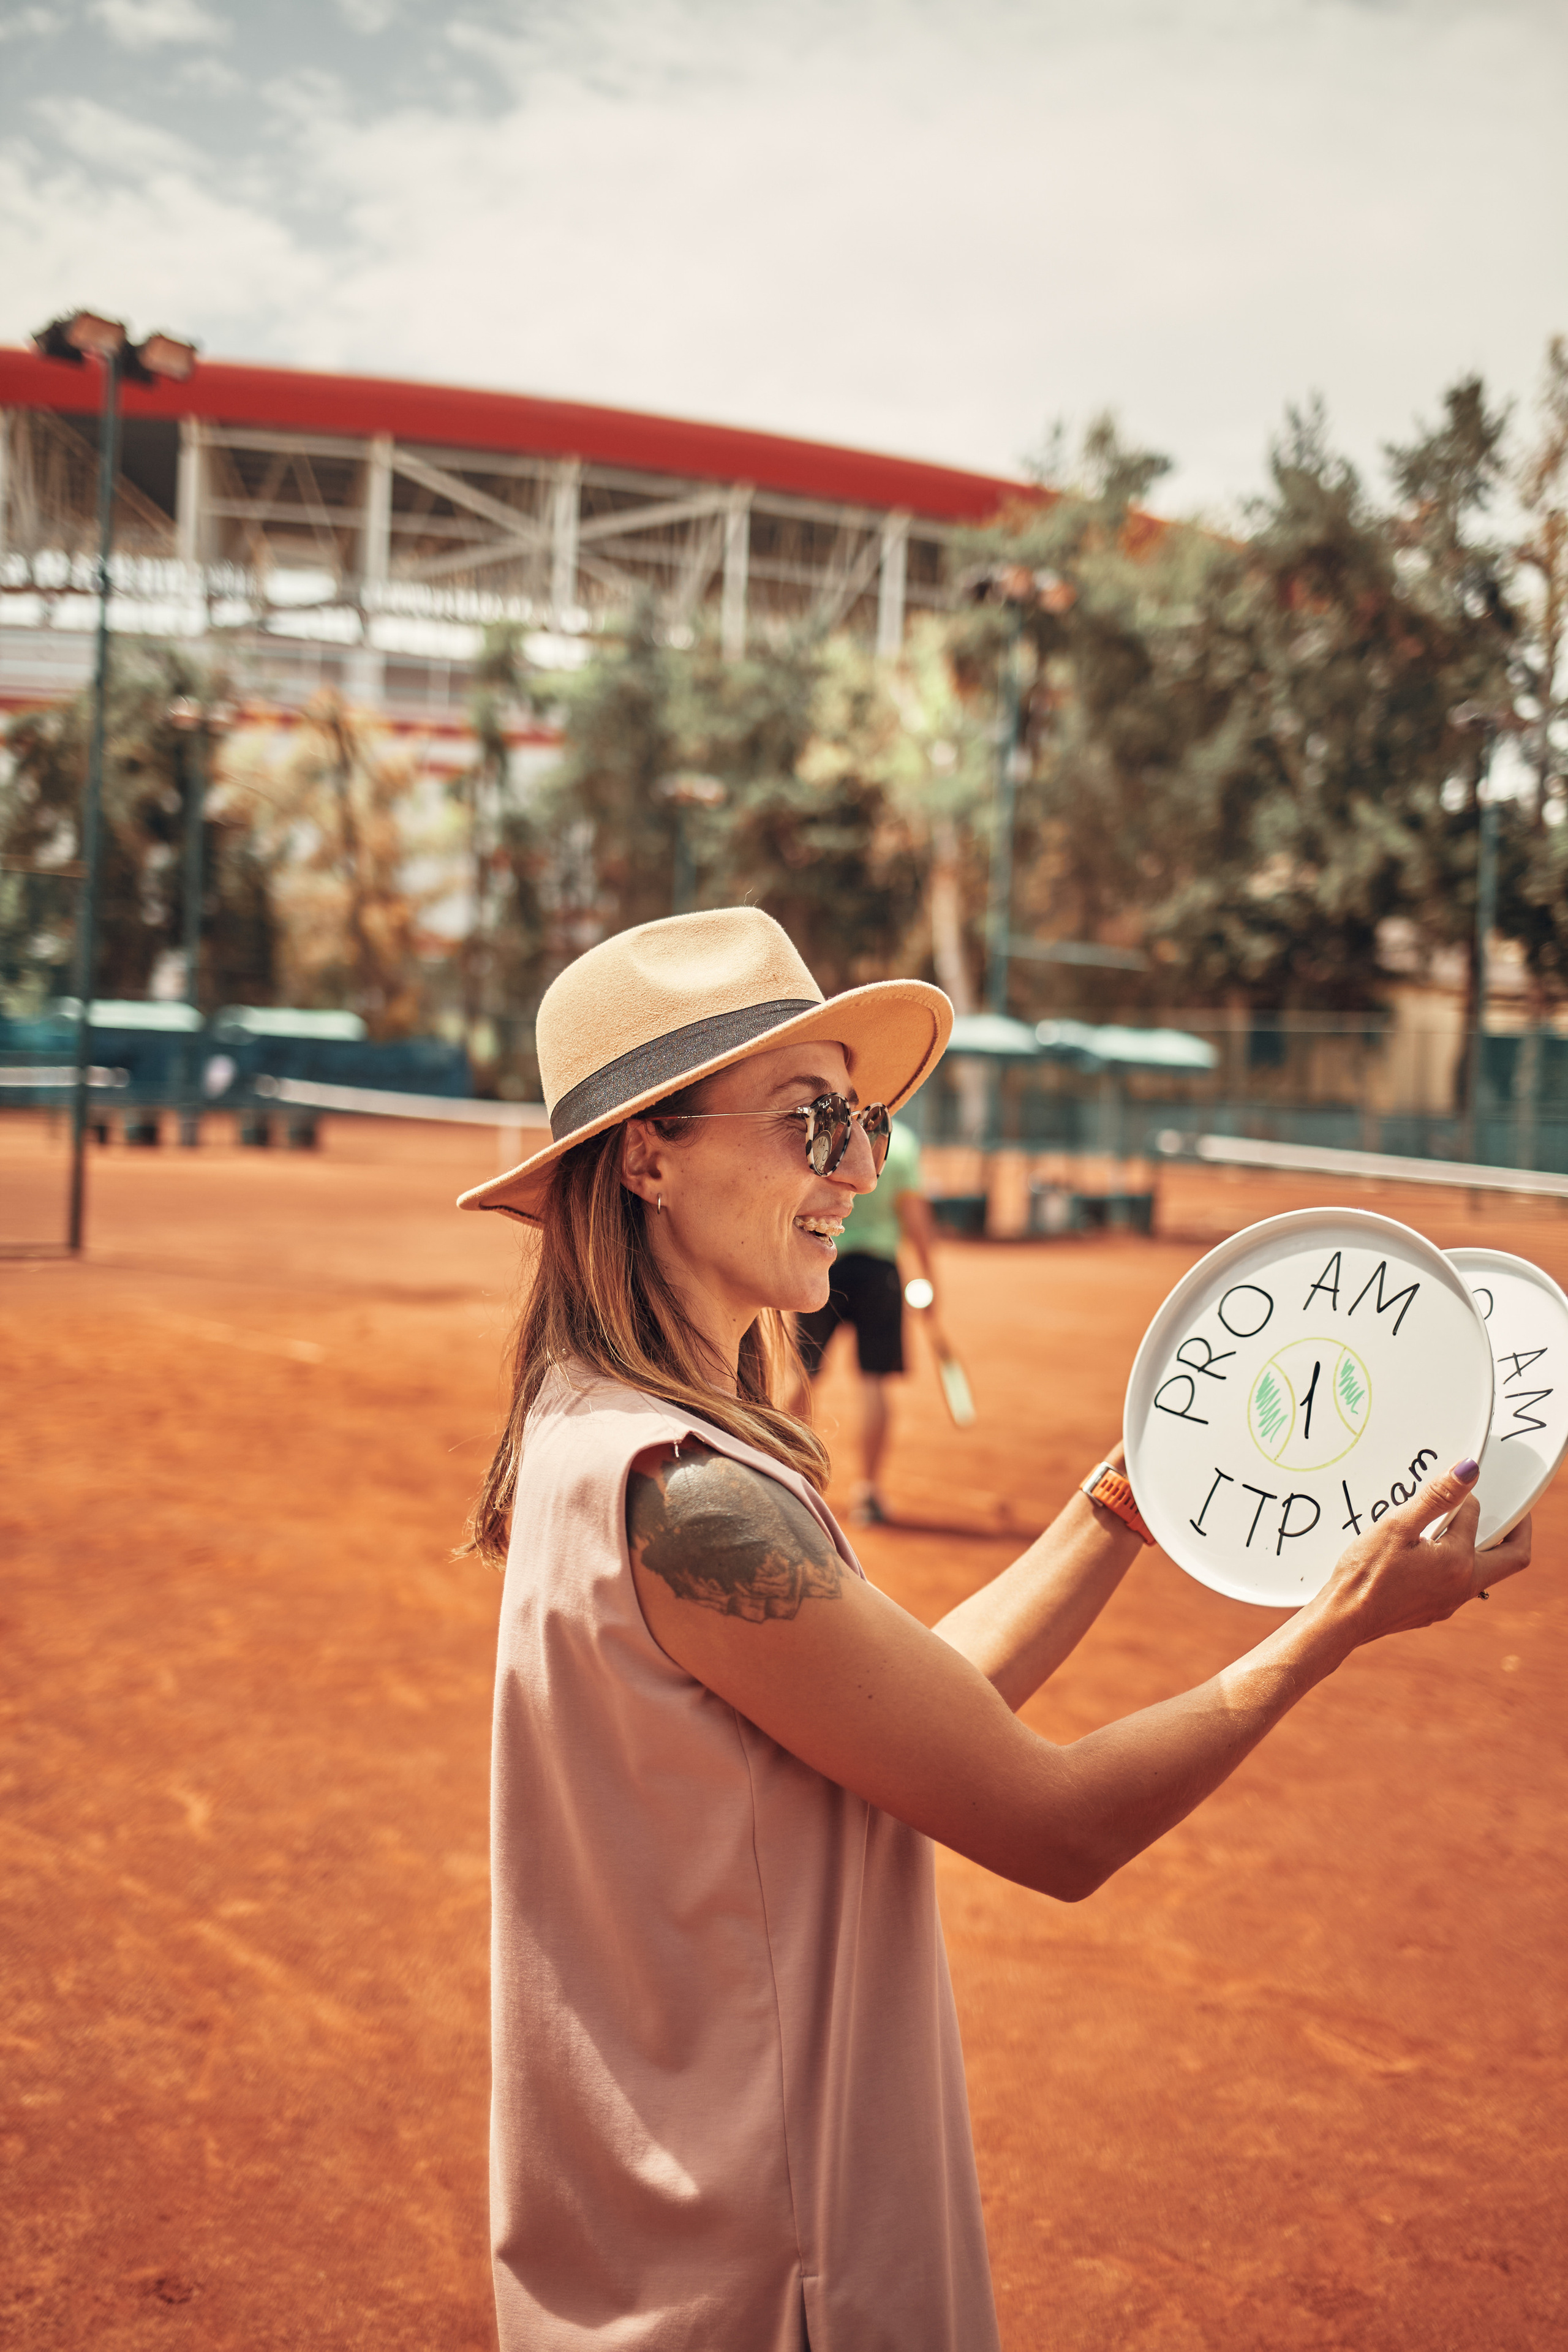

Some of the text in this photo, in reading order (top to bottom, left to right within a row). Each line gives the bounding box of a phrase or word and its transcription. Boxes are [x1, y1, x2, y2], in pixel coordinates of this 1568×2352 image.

[1154, 1251, 1420, 1425] PRO AM
[1299, 1361, 1321, 1440] 1
[1497, 1347, 1555, 1442] AM
[1189, 1449, 1438, 1556] ITP team
